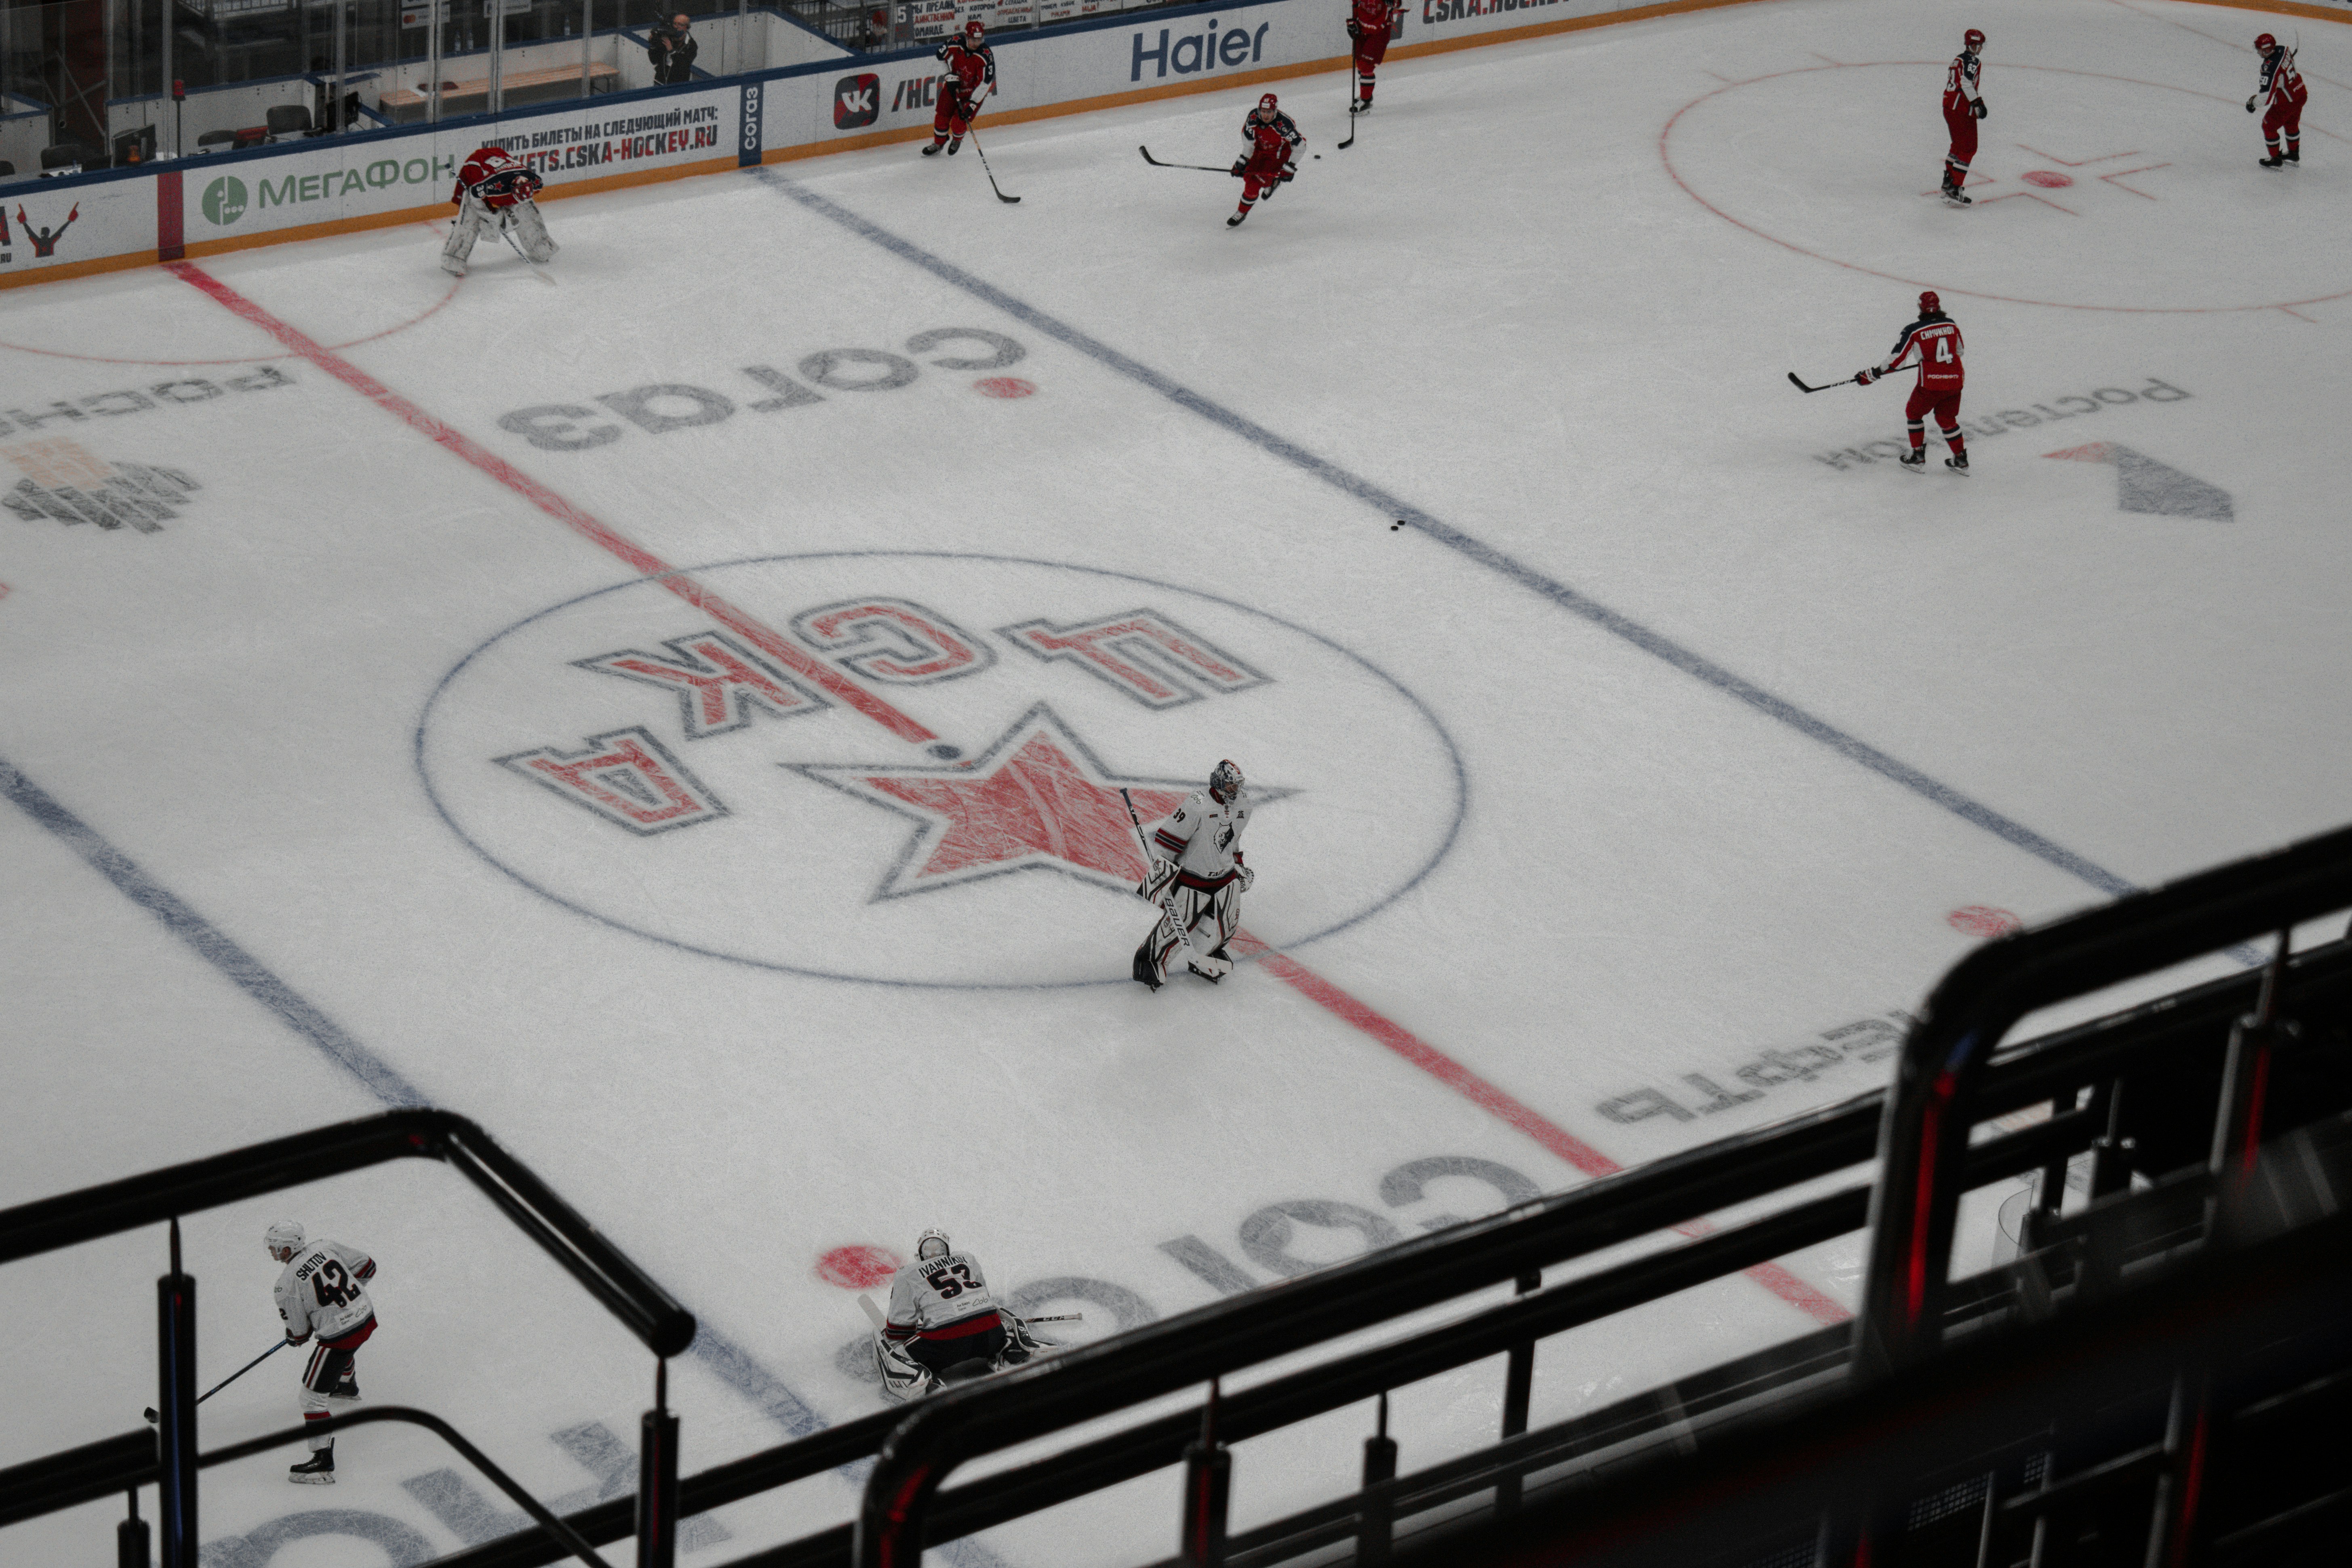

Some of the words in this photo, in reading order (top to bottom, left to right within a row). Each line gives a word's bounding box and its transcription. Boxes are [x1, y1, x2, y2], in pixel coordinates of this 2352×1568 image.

[1131, 19, 1269, 82] Haier
[988, 65, 993, 75] 3
[532, 126, 582, 148] БИЛЕТЫ
[585, 124, 600, 140] НА
[604, 108, 681, 137] СЛЕДУЮЩИЙ
[684, 106, 718, 125] МАТЧ:
[1286, 131, 1297, 141] 52
[1936, 337, 1954, 364] 4
[1173, 808, 1185, 823] 39
[296, 1252, 327, 1281] SHUTOV
[918, 1256, 968, 1278] IVANNIKOV
[312, 1259, 361, 1308] 42
